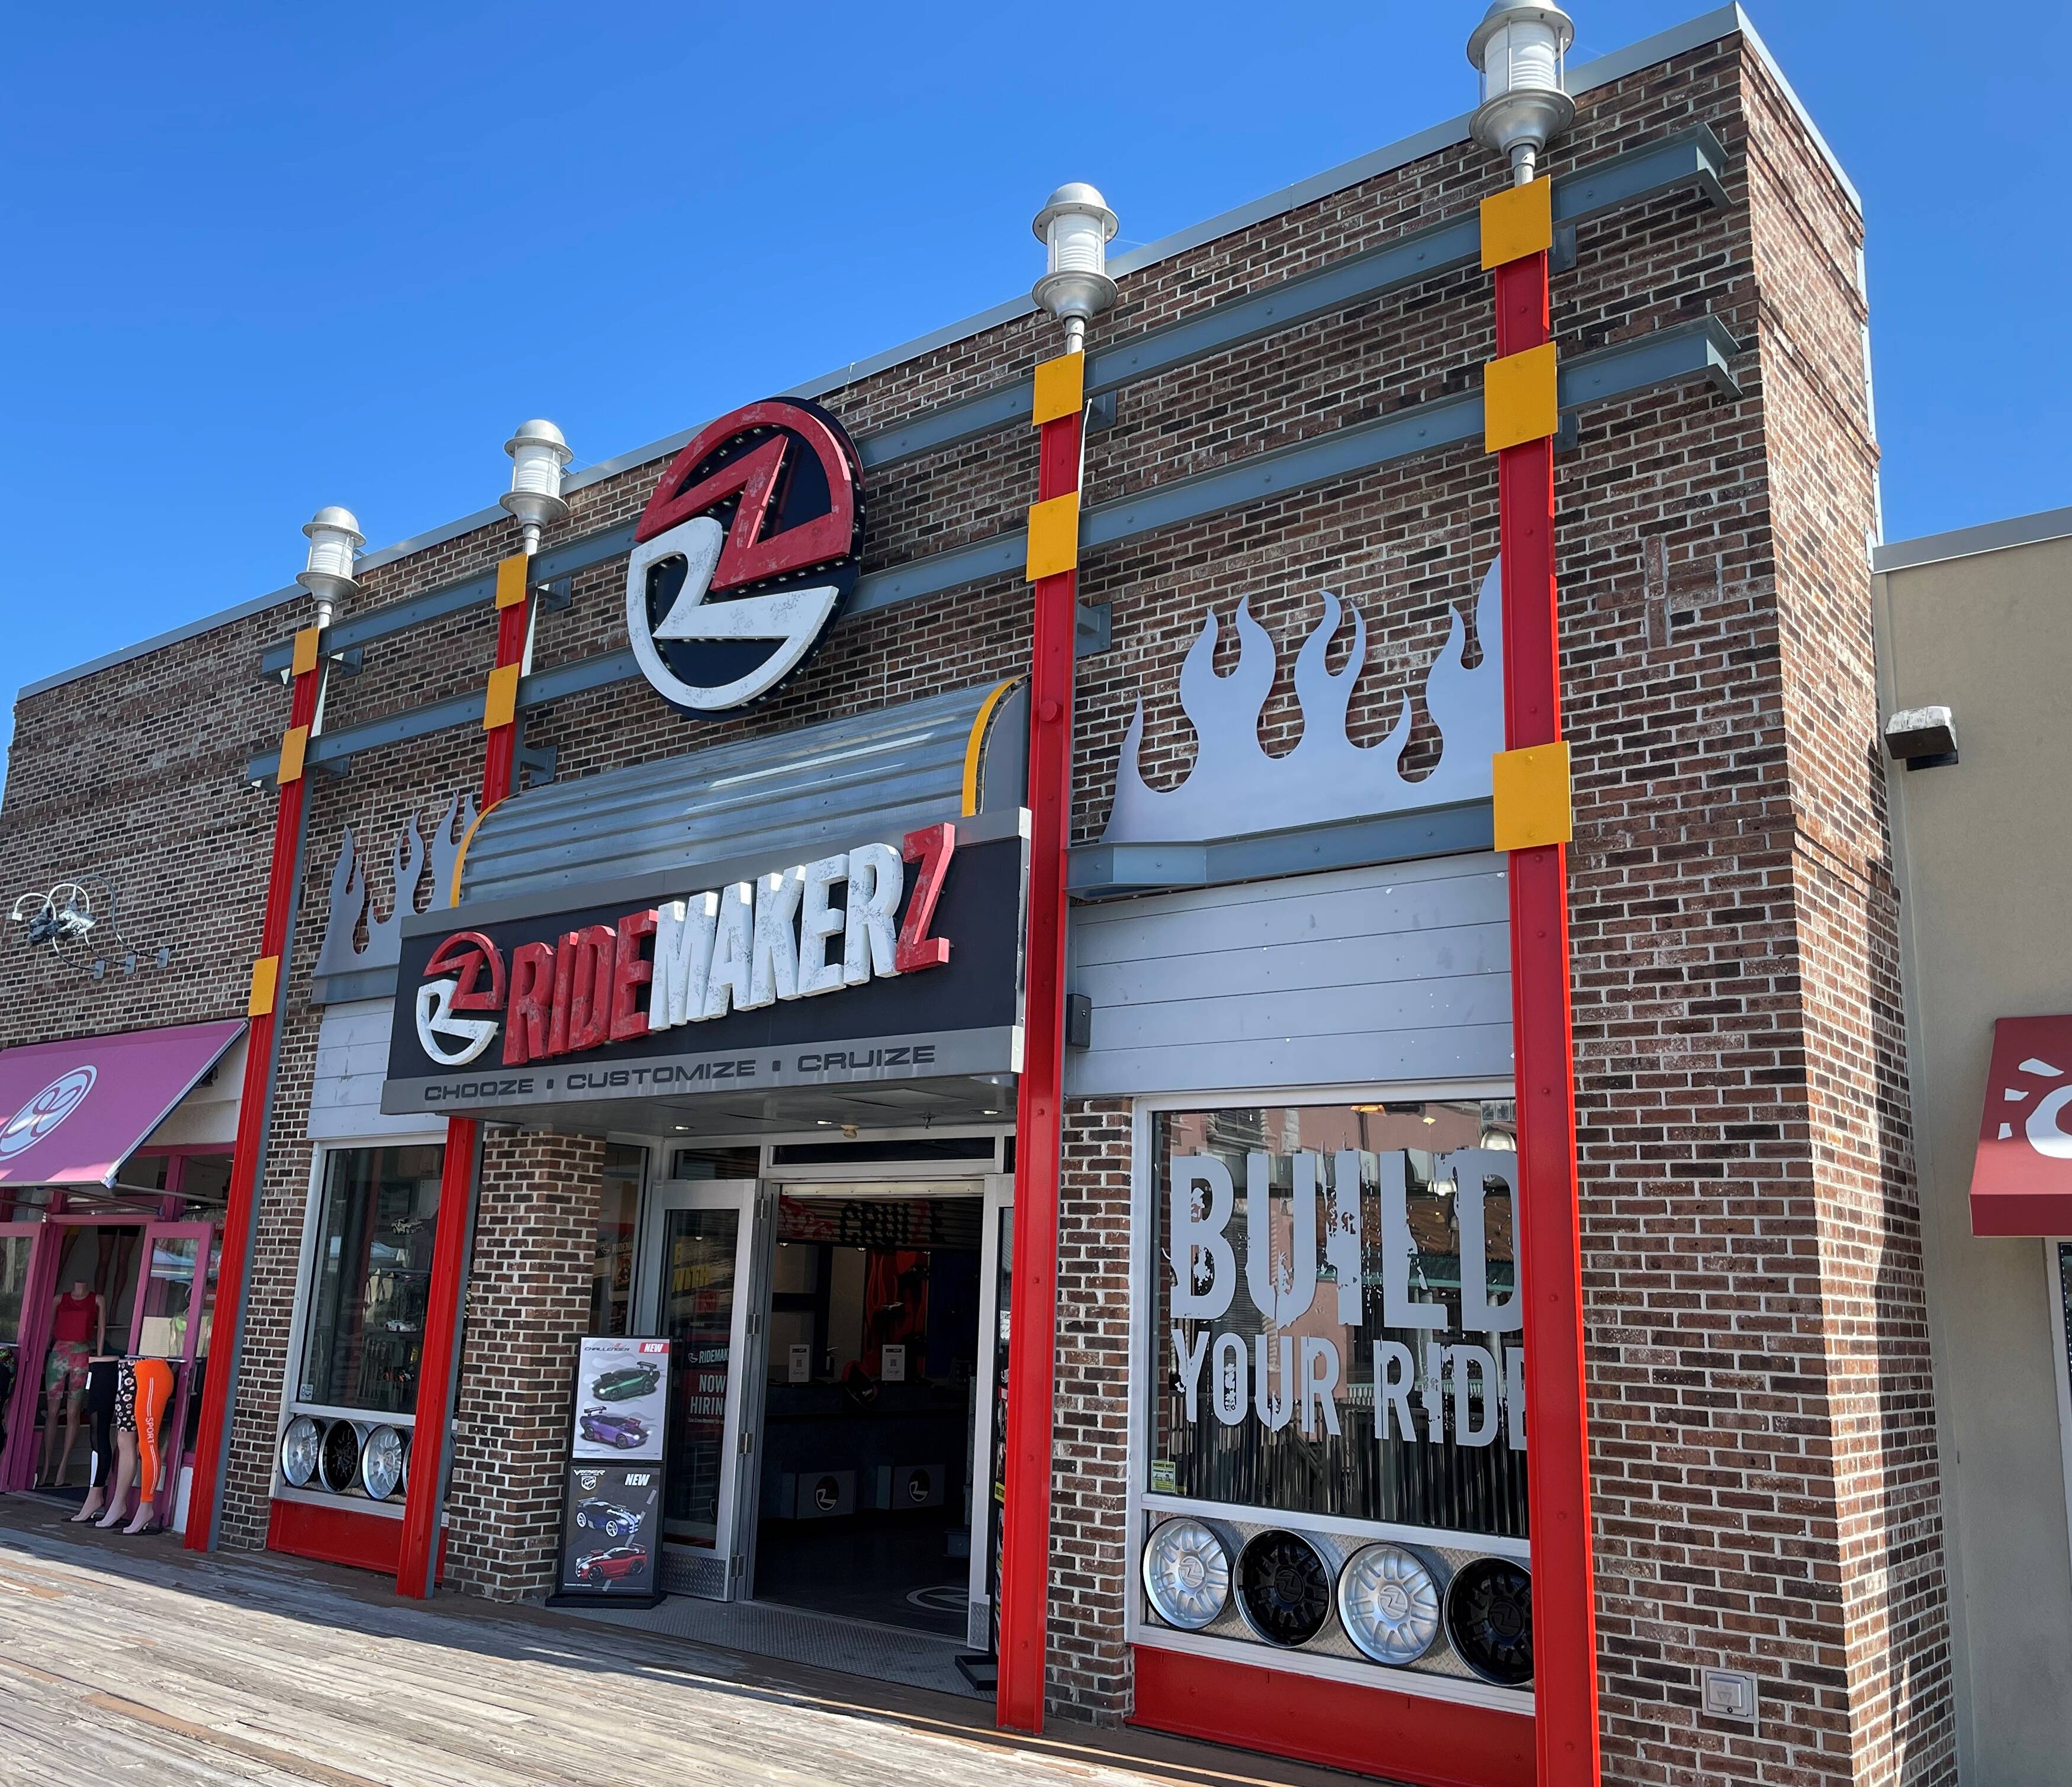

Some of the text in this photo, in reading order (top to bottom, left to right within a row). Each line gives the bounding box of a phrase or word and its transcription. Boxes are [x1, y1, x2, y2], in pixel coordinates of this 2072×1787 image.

[503, 822, 955, 1065] RIDEMAKERZ
[424, 1045, 935, 1100] CHOOZE CUSTOMIZE CRUIZE
[1170, 1148, 1523, 1332] BUILD
[644, 1343, 664, 1353] NEW
[699, 1348, 729, 1364] RIDEMAK
[699, 1374, 726, 1393] NOW
[1172, 1329, 1341, 1437] YOUR
[690, 1396, 725, 1416] HIRIN
[145, 1416, 155, 1444] SPORT
[625, 1473, 651, 1486] NEW
